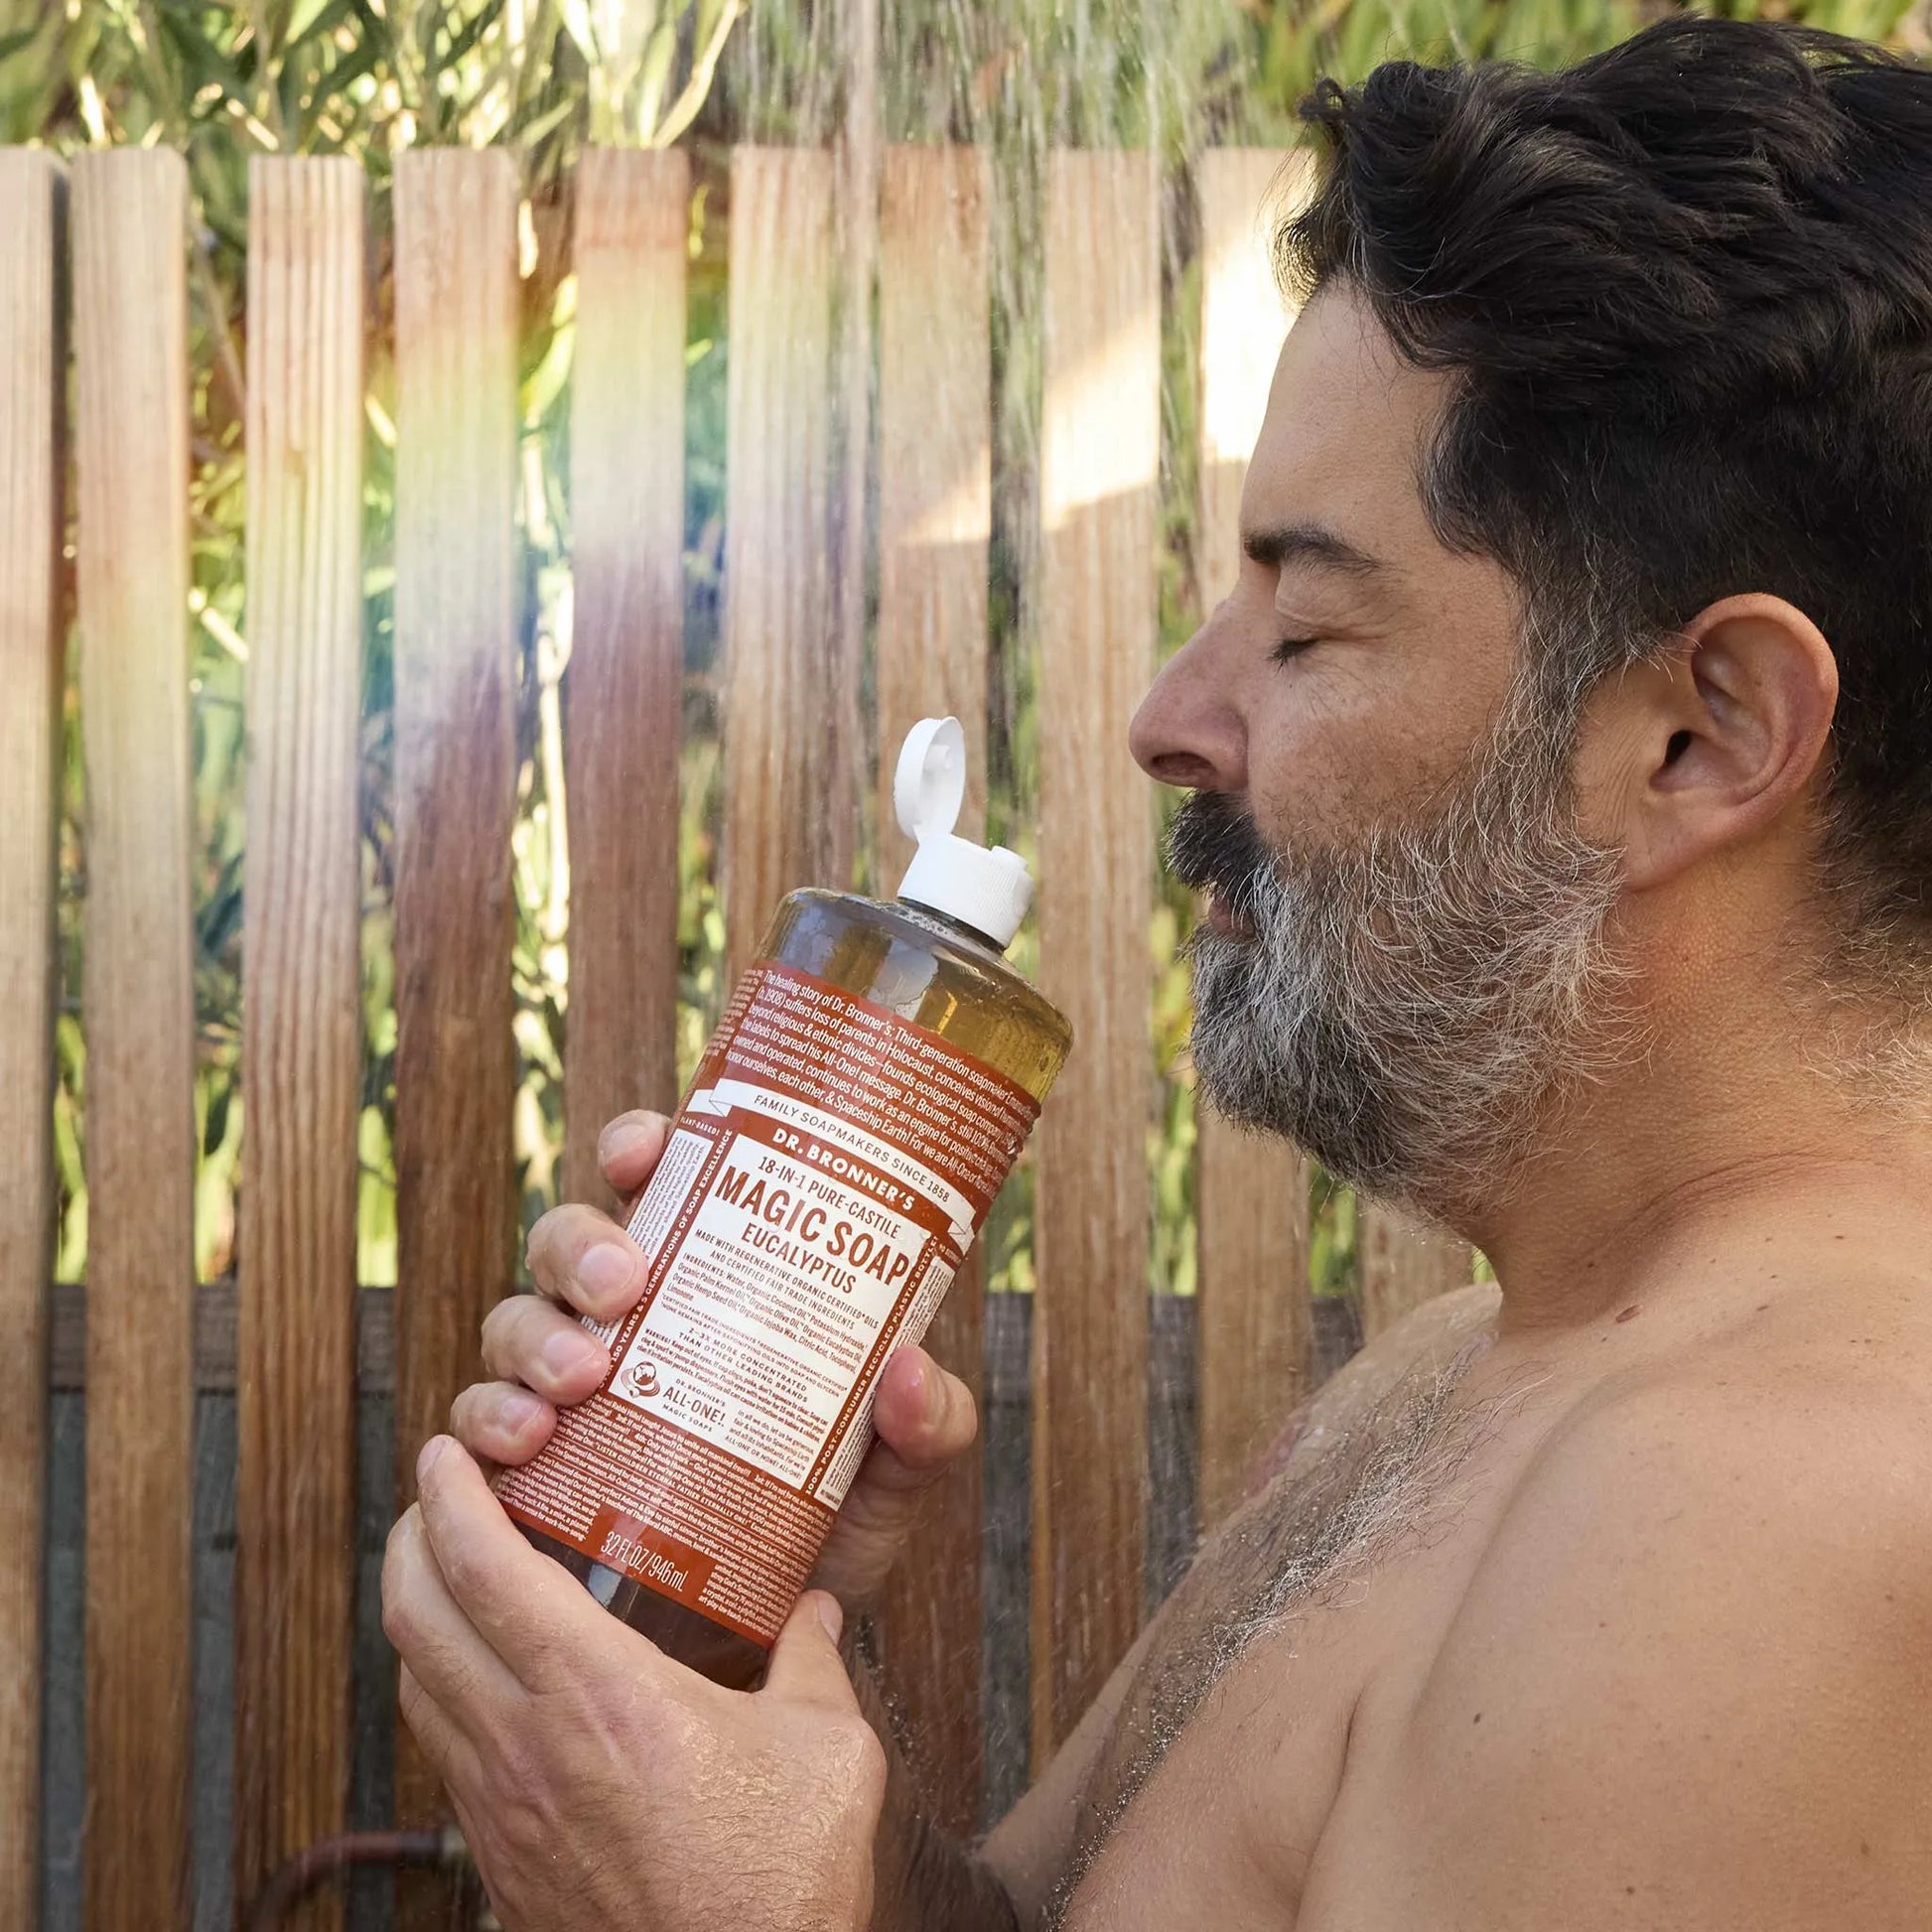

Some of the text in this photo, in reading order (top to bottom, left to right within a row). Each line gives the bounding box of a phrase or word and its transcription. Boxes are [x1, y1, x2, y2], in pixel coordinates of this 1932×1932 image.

[768, 1009, 807, 1035] religious
[802, 1023, 816, 1036] &
[811, 1026, 844, 1049] ethnic
[911, 1077, 961, 1115] ecological
[955, 1104, 977, 1125] soap
[782, 996, 814, 1018] suffers
[810, 1007, 832, 1026] loss
[827, 1016, 842, 1031] of
[837, 1020, 879, 1049] parents
[875, 1037, 889, 1052] in
[884, 1042, 937, 1080] Holocaust,
[933, 1068, 977, 1101] conceives
[797, 984, 824, 1005] story
[821, 993, 834, 1007] of
[830, 997, 848, 1013] Dr.
[891, 1027, 971, 1080] Third-generation
[763, 1044, 808, 1075] operated,
[804, 1061, 854, 1093] continues
[850, 1083, 865, 1099] to
[861, 1089, 889, 1111] work
[884, 1104, 898, 1118] as
[896, 1110, 911, 1124] an
[906, 1114, 941, 1143] engine
[937, 1130, 952, 1147] for
[768, 1027, 782, 1040] to
[775, 1031, 810, 1055] spread
[805, 1042, 824, 1059] his
[820, 1048, 861, 1077] All-One!
[856, 1070, 904, 1103] message.
[901, 1090, 919, 1108] Dr.
[913, 1097, 961, 1133] Bronner's,
[776, 1068, 802, 1088] each
[796, 1077, 828, 1102] other,
[824, 1090, 838, 1105] &
[831, 1094, 885, 1131] Spaceship
[881, 1118, 911, 1144] Earth!
[907, 1134, 926, 1152] For
[921, 1144, 937, 1159] we
[933, 1151, 949, 1166] are
[754, 1094, 799, 1118] FAMILY
[799, 1111, 891, 1163] SOAPMAKERS
[891, 1157, 927, 1186] SINCE
[926, 1179, 950, 1203] 1858
[771, 1127, 808, 1154] DR.
[805, 1143, 916, 1211] BRONNER'S
[619, 1312, 639, 1345] YEARS
[643, 1229, 682, 1296] GENERATIONS
[677, 1214, 688, 1229] OF
[684, 1188, 702, 1216] SOAP
[698, 1128, 733, 1188] EXCELLENCE
[713, 1164, 831, 1245] MAGIC
[822, 1218, 912, 1290] SOAP
[757, 1156, 901, 1239] 18-IN-1 PURE-CASTILE
[694, 1227, 716, 1243] MADE
[714, 1237, 736, 1253] WITH
[734, 1247, 792, 1282] REGENERATIVE
[790, 1275, 827, 1300] ORGANIC
[863, 1314, 880, 1329] OILS
[709, 1249, 855, 1329] AND CERTIFIED FAIR TRADE INGREDIENTS
[725, 1272, 747, 1289] Water,
[744, 1282, 771, 1302] Organic
[769, 1295, 798, 1313] Coconut
[740, 1221, 858, 1295] EUCALYPTUS
[747, 1296, 775, 1316] Organic
[864, 1324, 895, 1377] RECYCLED
[892, 1281, 916, 1323] PLASTIC
[662, 1384, 726, 1426] ALL-ONE!
[677, 1331, 808, 1403] THAN OTHER LEADING BRANDS
[713, 1338, 807, 1392] MORE CONCENTRATED
[662, 1403, 713, 1433] MAGIC SOAPS
[599, 1530, 621, 1556] 32
[614, 1538, 635, 1564] FL
